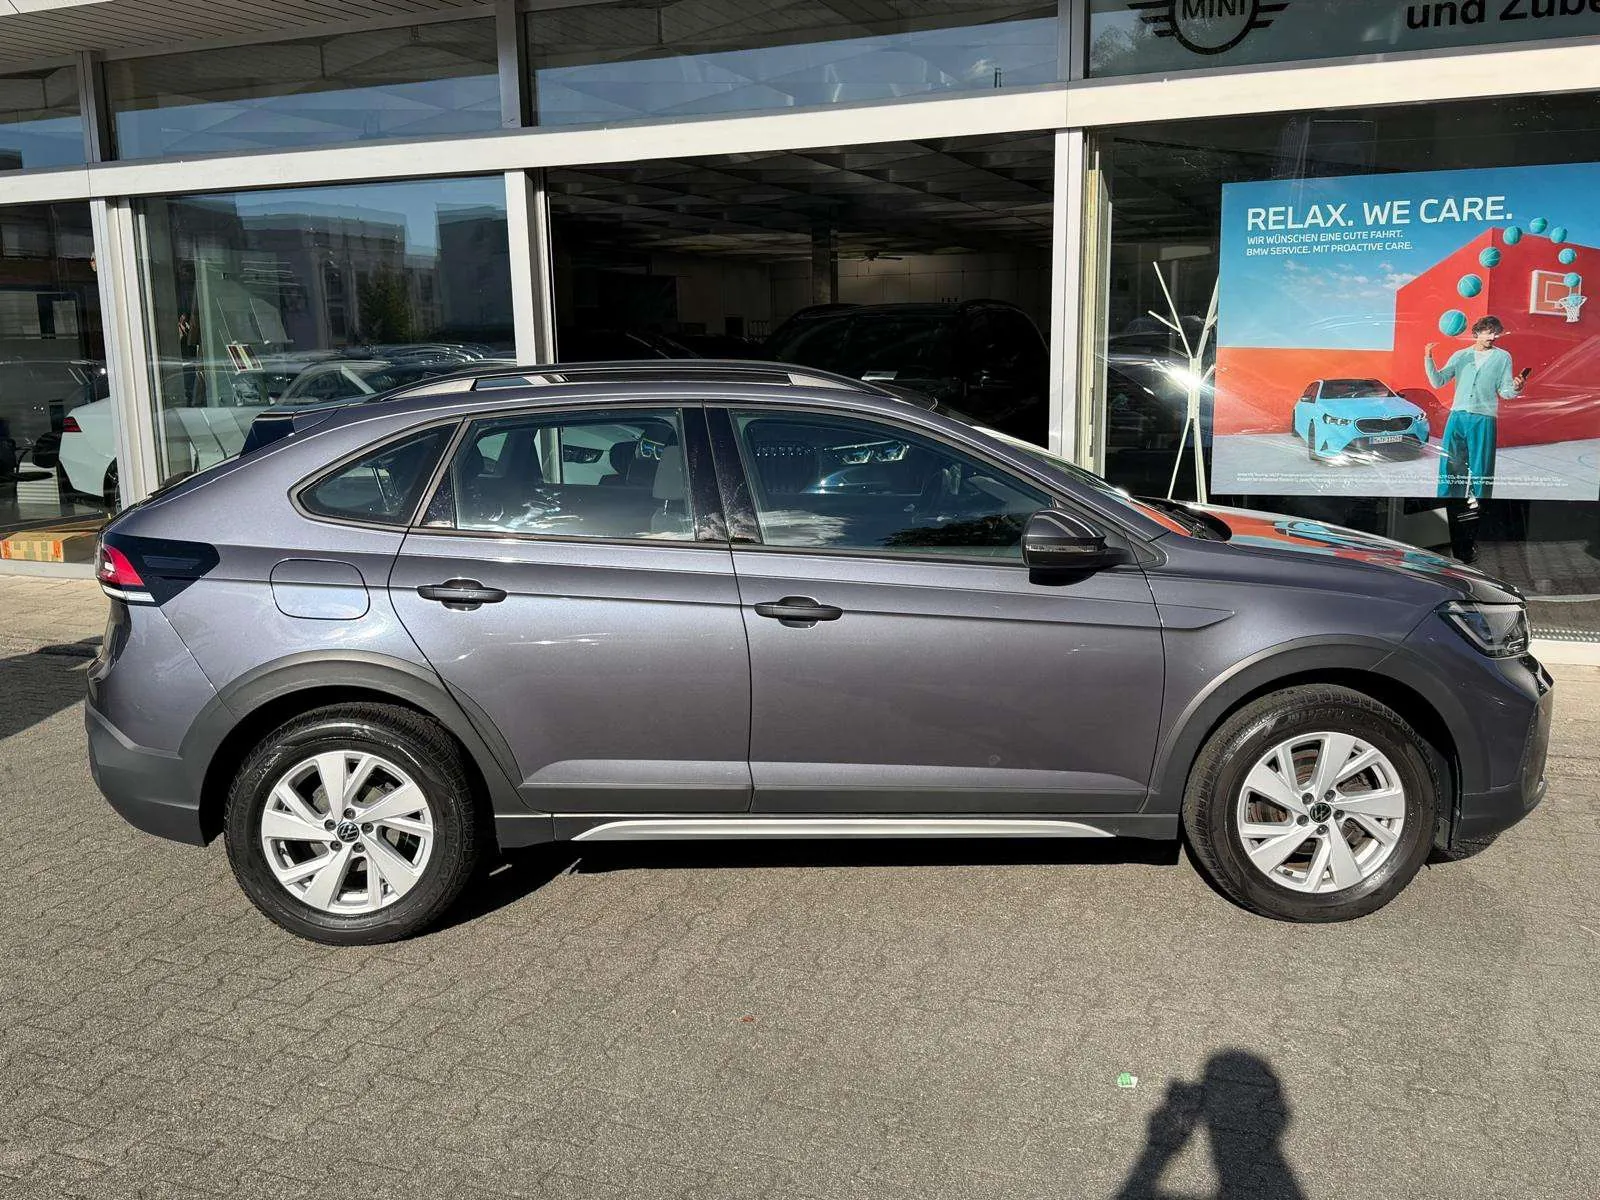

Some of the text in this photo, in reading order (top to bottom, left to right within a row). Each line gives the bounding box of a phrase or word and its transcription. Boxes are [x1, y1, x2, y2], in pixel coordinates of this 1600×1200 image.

[1182, 0, 1246, 20] MINI
[1406, 0, 1486, 30] und
[1247, 196, 1513, 231] RELAX. WE CARE.
[1247, 229, 1404, 245] WIR WÜNSCHEN EINE GUTE FAHRT.
[1246, 241, 1413, 256] BMW SERVICE. MIT PROACTIVE CARE.
